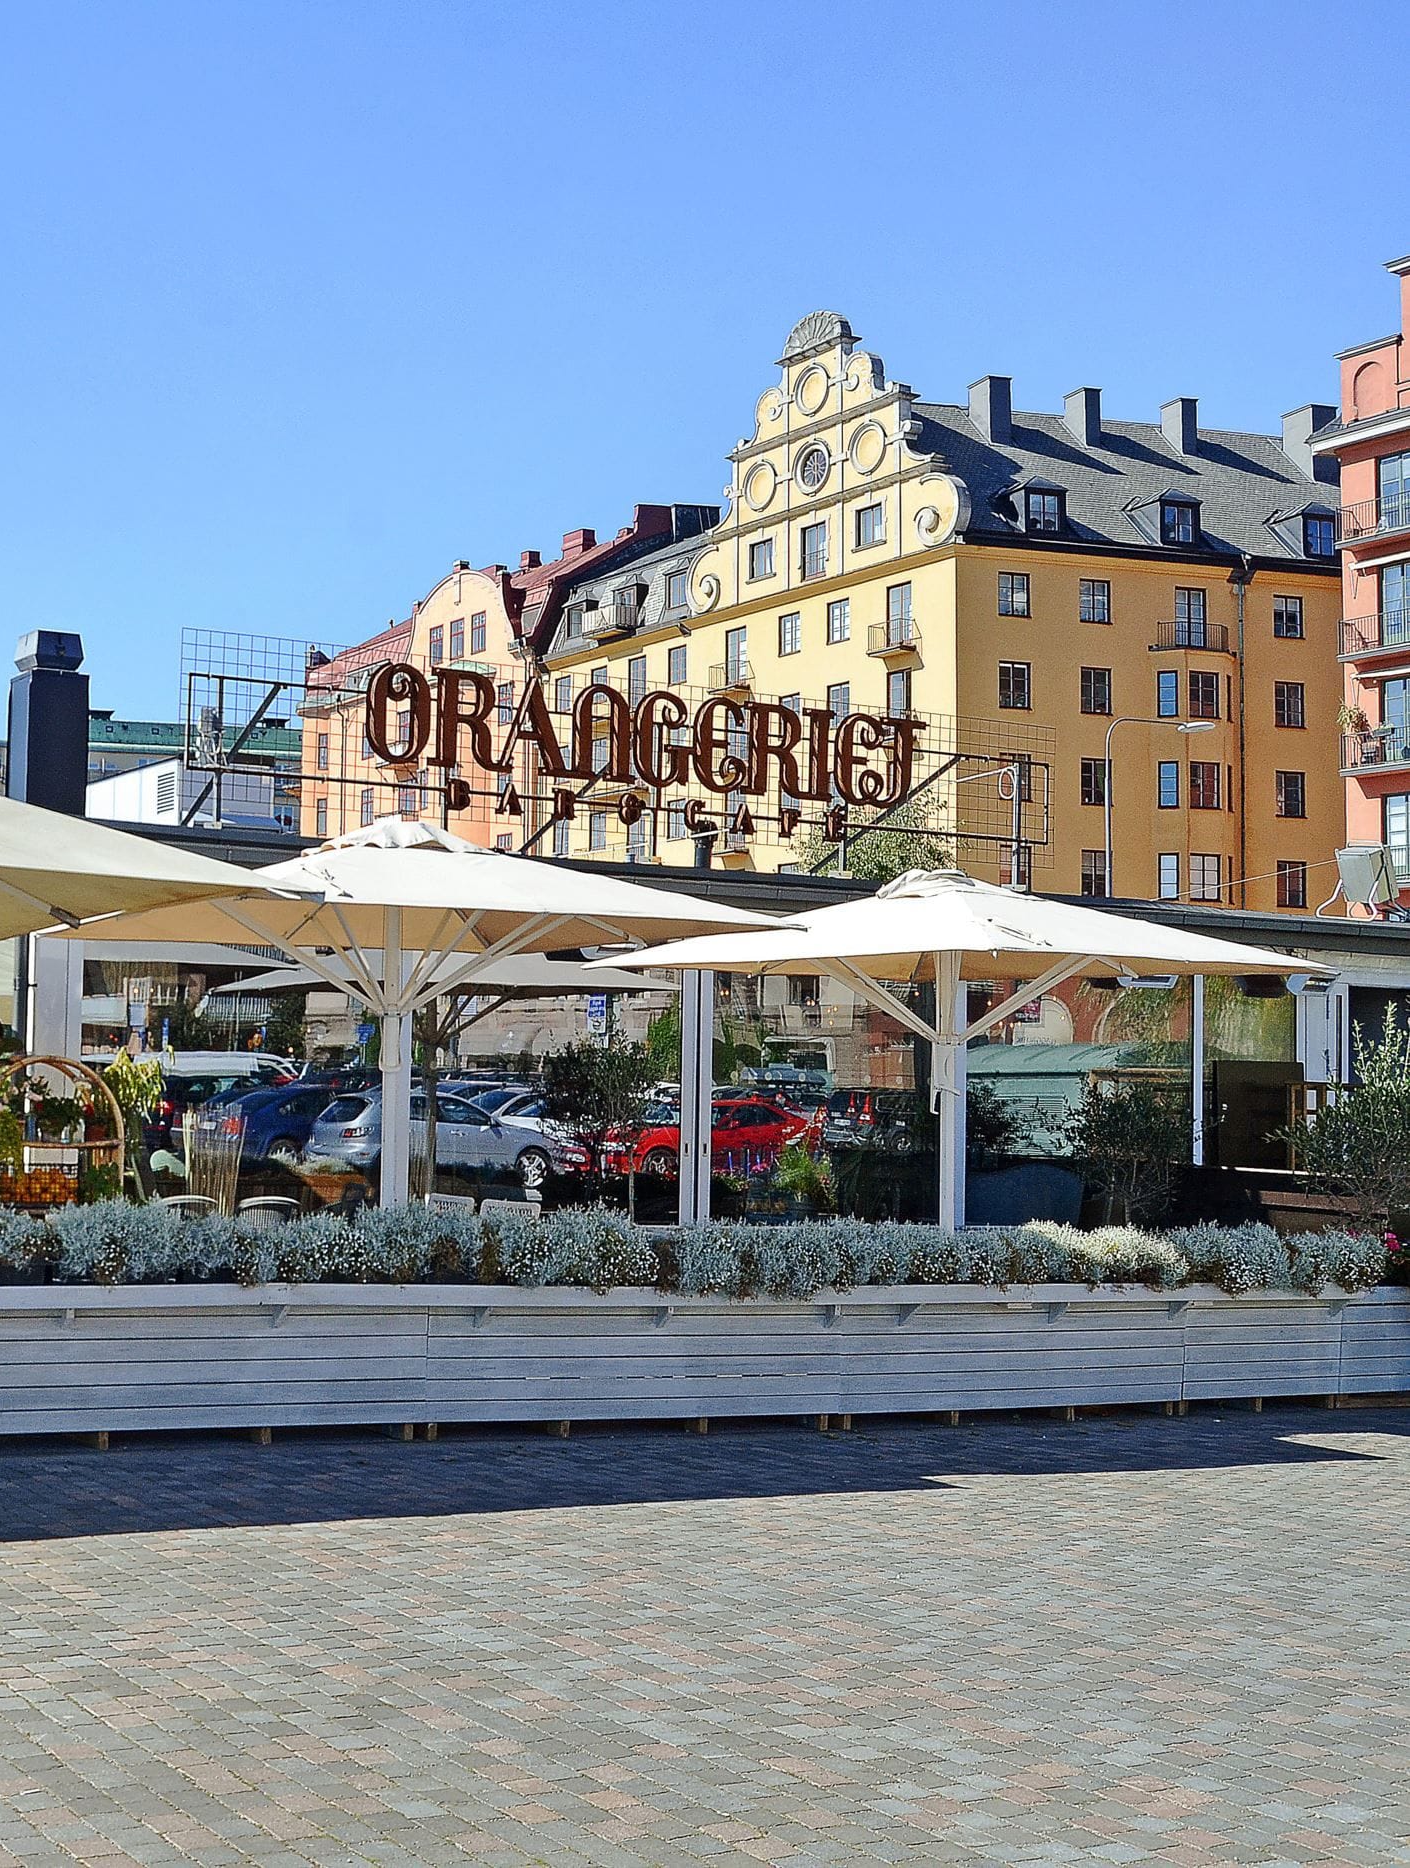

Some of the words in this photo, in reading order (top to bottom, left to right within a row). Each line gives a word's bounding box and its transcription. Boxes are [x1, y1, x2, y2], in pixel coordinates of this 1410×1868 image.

[366, 662, 927, 809] ORANGERIET
[447, 778, 577, 821] BAR
[618, 793, 646, 825] &
